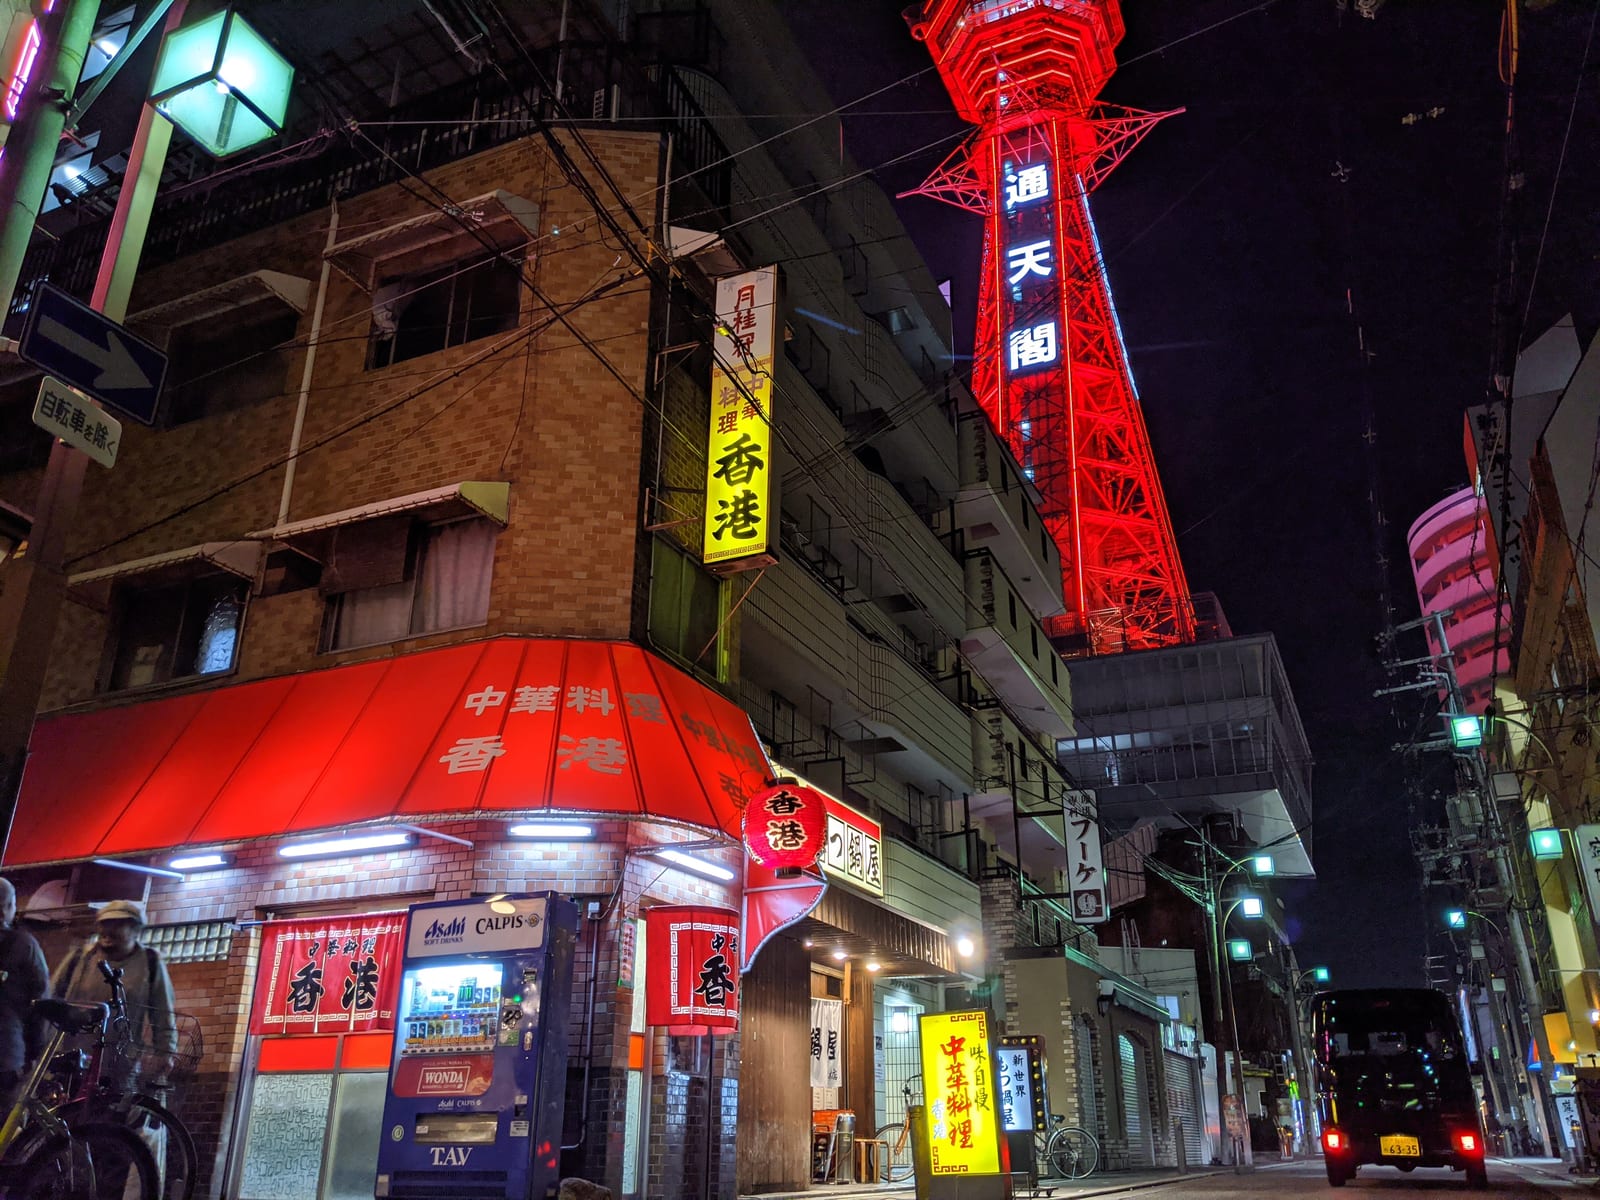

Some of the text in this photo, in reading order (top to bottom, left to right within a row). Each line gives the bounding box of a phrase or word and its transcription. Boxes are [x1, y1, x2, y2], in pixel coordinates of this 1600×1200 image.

[1005, 163, 1057, 371] 通天閣
[732, 284, 757, 359] 月桂冠
[40, 390, 116, 457] 自転車を除く
[717, 386, 741, 435] 料理
[742, 374, 764, 420] 中華
[712, 433, 765, 541] 香港
[464, 685, 667, 725] 中華料理
[439, 735, 628, 775] 香港
[766, 790, 807, 850] 香港
[1071, 819, 1097, 885] フーケ
[308, 937, 377, 958] 中華料理
[424, 915, 523, 939] Asahi CALPIS
[424, 936, 464, 946] SOFT DRINKS
[288, 957, 380, 1012] 香港
[695, 954, 736, 1007] 香
[425, 1071, 464, 1084] WONDA
[940, 1035, 974, 1149] 中華料理
[970, 1043, 991, 1112] 味自慢
[1013, 1054, 1027, 1098] 新世界
